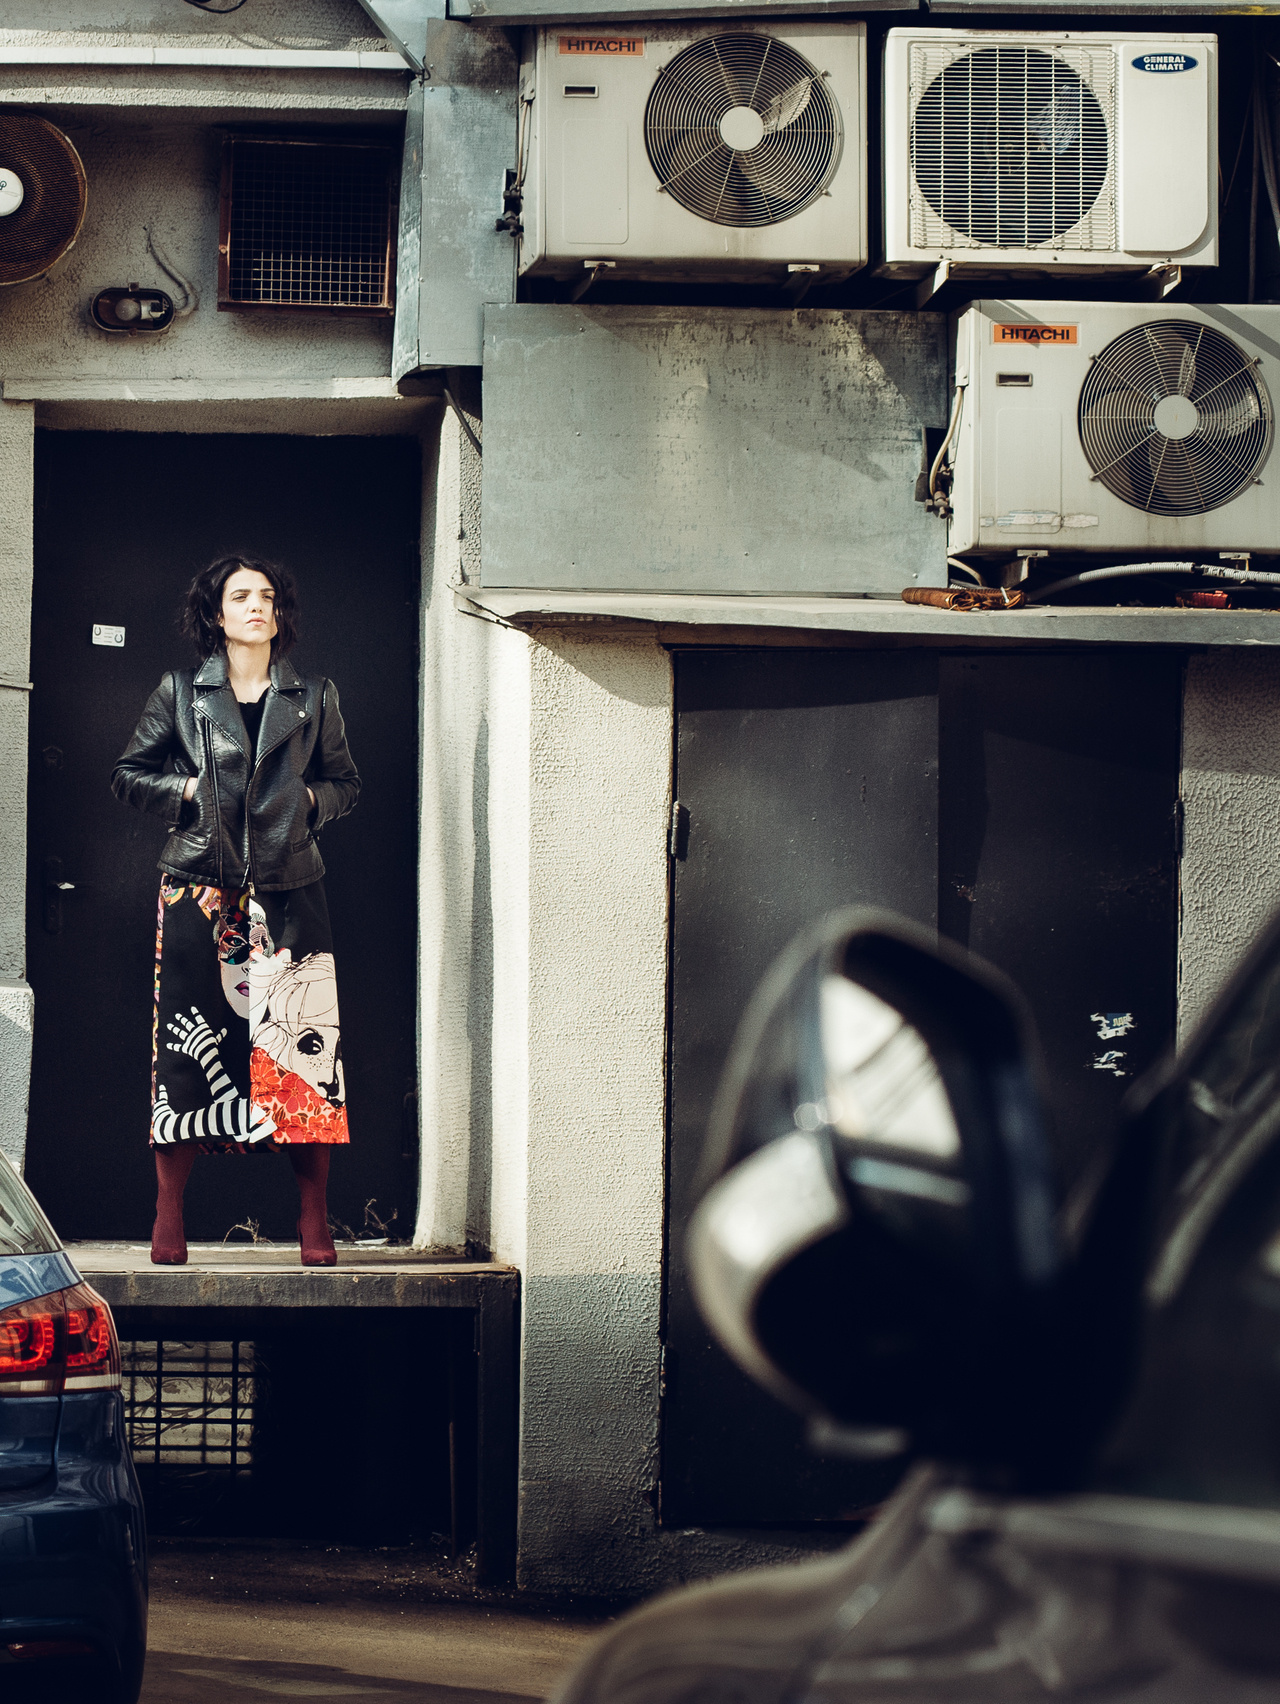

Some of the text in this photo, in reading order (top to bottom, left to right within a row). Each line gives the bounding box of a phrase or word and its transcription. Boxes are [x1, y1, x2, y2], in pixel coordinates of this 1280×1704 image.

[567, 40, 636, 52] HITACHI
[1144, 63, 1184, 71] CLIMATE
[1001, 328, 1070, 340] HITACHI
